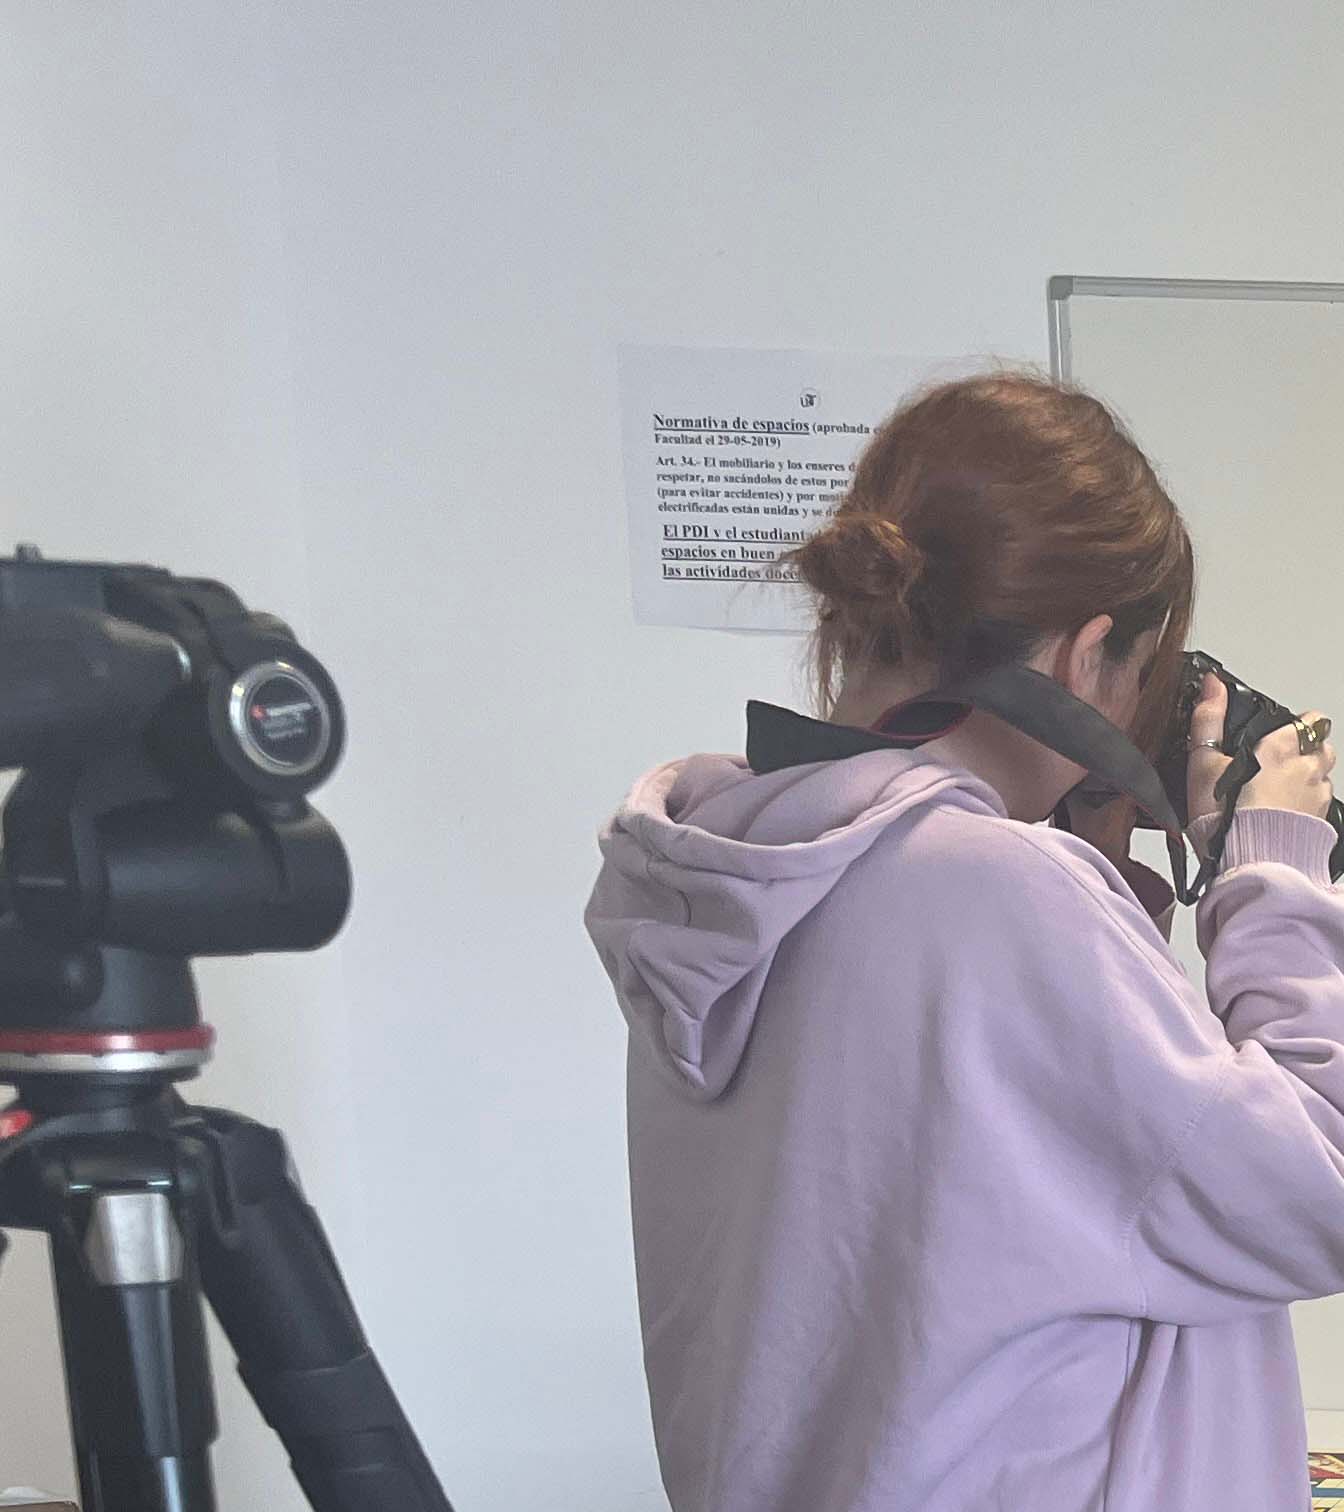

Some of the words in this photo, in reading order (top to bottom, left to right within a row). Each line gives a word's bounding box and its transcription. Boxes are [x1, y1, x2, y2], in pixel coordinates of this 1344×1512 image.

[653, 413, 729, 430] Normativa
[732, 417, 749, 431] de
[752, 418, 810, 433] espacios
[812, 422, 870, 435] (aprobada
[654, 433, 702, 445] Facultad
[705, 435, 715, 445] el
[718, 435, 781, 449] 29-05-2019)
[656, 455, 677, 466] Art.
[703, 456, 717, 467] El
[719, 458, 775, 469] mobiliario
[778, 461, 784, 472] y
[787, 460, 802, 470] los
[805, 462, 846, 472] enseres
[657, 473, 704, 484] respetar,
[707, 475, 721, 483] no
[724, 474, 782, 485] sacándolos
[785, 475, 799, 486] de
[801, 478, 827, 487] estos
[830, 478, 849, 489] por
[657, 487, 687, 499] (para
[690, 488, 722, 498] evitar
[724, 489, 784, 501] accidentes)
[787, 491, 793, 502] y
[796, 493, 816, 503] por
[658, 502, 729, 513] electrificadas
[732, 504, 760, 514] están
[762, 505, 799, 516] unidas
[801, 508, 808, 519] y
[663, 524, 678, 538] El
[682, 525, 709, 538] PDI
[713, 528, 721, 540] y
[725, 526, 738, 539] el
[741, 527, 817, 542] estudiant
[661, 545, 717, 559] espacios
[720, 548, 737, 558] en
[740, 547, 775, 560] buen
[661, 563, 682, 577] las
[685, 566, 761, 579] actividades
